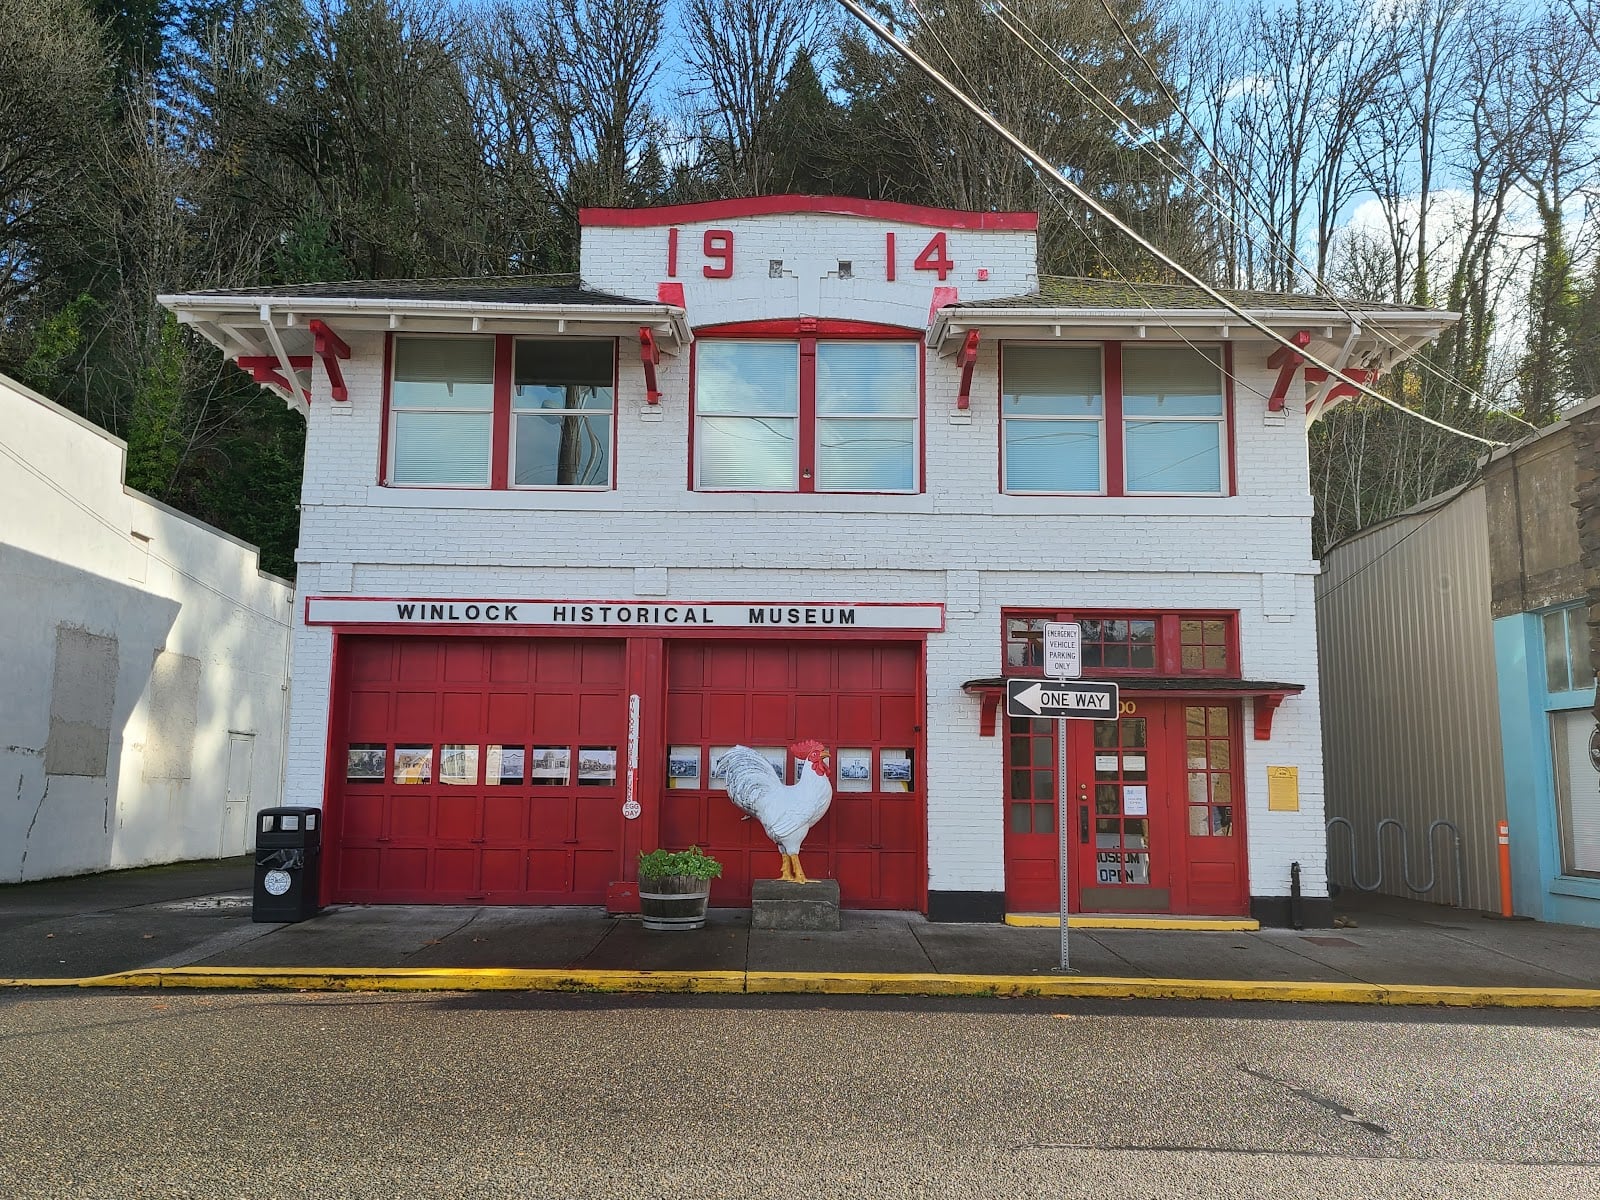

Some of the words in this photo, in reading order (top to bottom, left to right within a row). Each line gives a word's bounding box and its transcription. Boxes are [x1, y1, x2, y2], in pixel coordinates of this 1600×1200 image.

[397, 604, 519, 621] WINLOCK
[553, 605, 714, 623] HISTORICAL
[748, 607, 855, 625] MUSEUM
[1047, 630, 1077, 638] EMERGENCY
[1049, 641, 1076, 649] VEHICLE
[1049, 651, 1076, 660] PARKING
[1054, 662, 1071, 670] ONLY
[1041, 692, 1070, 707] ONE
[1075, 693, 1105, 708] WAY
